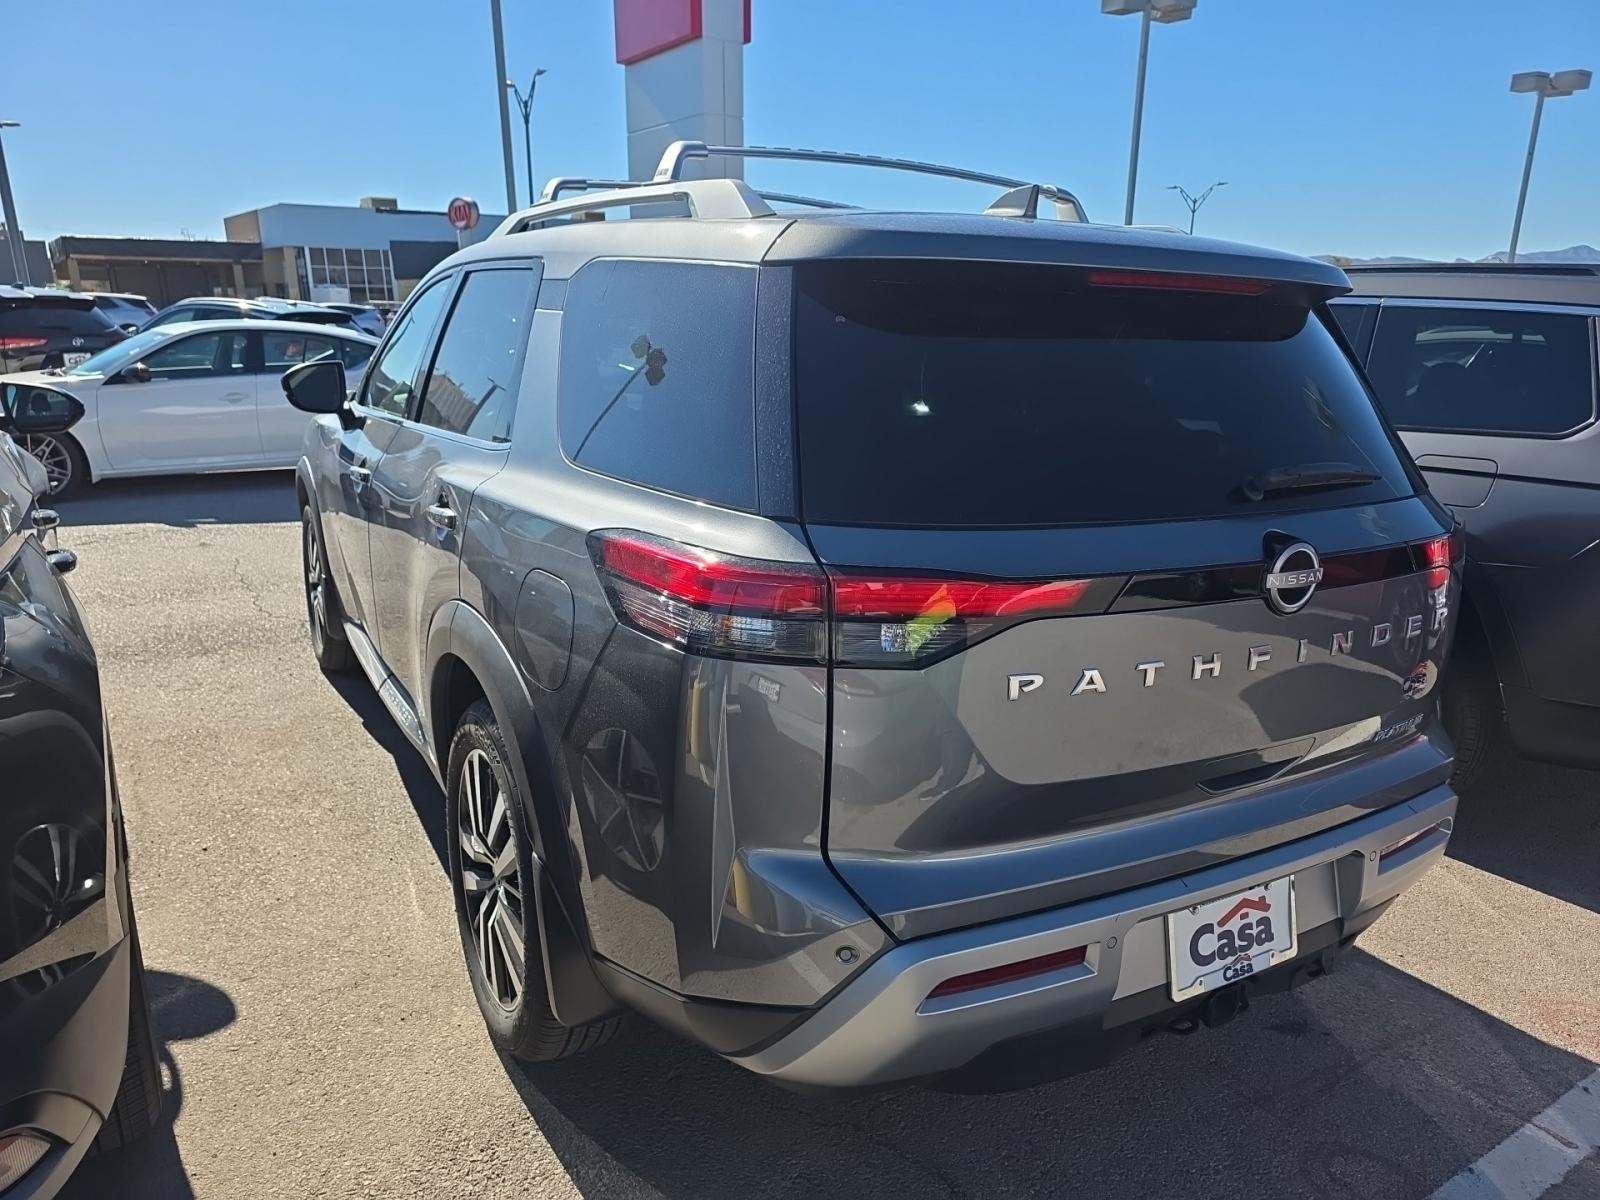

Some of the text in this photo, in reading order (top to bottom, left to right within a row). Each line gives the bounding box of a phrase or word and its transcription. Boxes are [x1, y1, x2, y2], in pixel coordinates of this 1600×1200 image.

[1268, 569, 1323, 587] NISSAN
[1008, 607, 1448, 701] PATHFINDER
[1190, 916, 1274, 967] Casa
[1223, 962, 1254, 982] Casa
